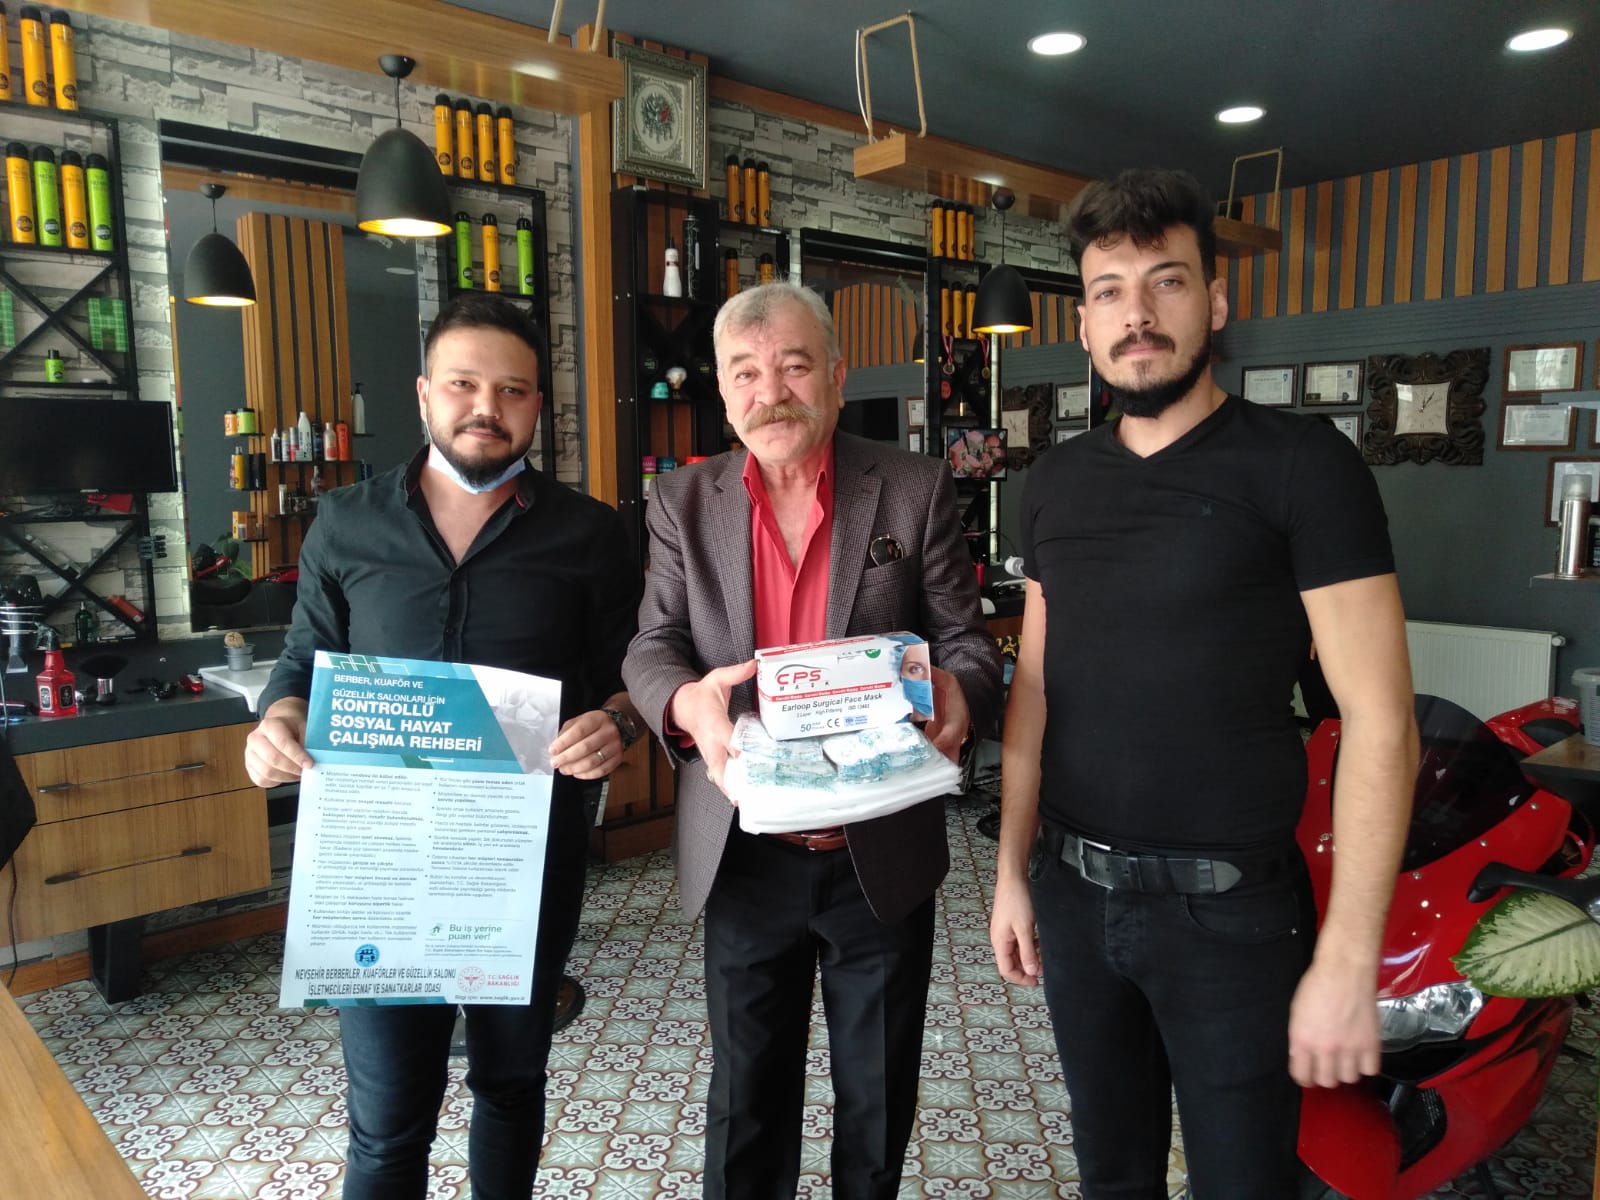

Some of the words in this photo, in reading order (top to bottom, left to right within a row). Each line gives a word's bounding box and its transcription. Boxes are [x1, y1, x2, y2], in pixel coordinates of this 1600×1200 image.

[334, 674, 372, 686] BERBER,
[374, 678, 410, 688] KUAFÖR
[412, 681, 424, 689] VE
[776, 669, 822, 685] CPS
[332, 688, 375, 700] GÜZELLİK
[377, 692, 426, 703] SALONLARI
[782, 703, 811, 713] Earloop
[812, 697, 843, 708] Surgical
[844, 695, 862, 704] Face
[864, 692, 883, 701] Mask
[331, 697, 434, 717] KONTROLLÜ
[330, 714, 396, 731] SOSYAL
[400, 719, 453, 734] HAYAT
[800, 723, 812, 733] 50
[826, 718, 840, 728] CE
[329, 730, 405, 749] ÇALIŞMA
[409, 735, 483, 752] REHBERİ
[449, 924, 462, 932] Bu
[464, 924, 472, 933] iş
[474, 925, 502, 934] yerine
[448, 933, 471, 941] puan
[295, 967, 325, 981] NEVŞEHİR
[363, 966, 397, 979] KUAFÖRLER
[398, 968, 406, 979] VE
[406, 966, 433, 979] GÜZELLİK
[433, 968, 457, 979] SALONU
[352, 983, 372, 995] ESNAF
[373, 983, 381, 994] VE
[380, 983, 423, 994] SANATKARLAR
[424, 982, 442, 993] ODASI
